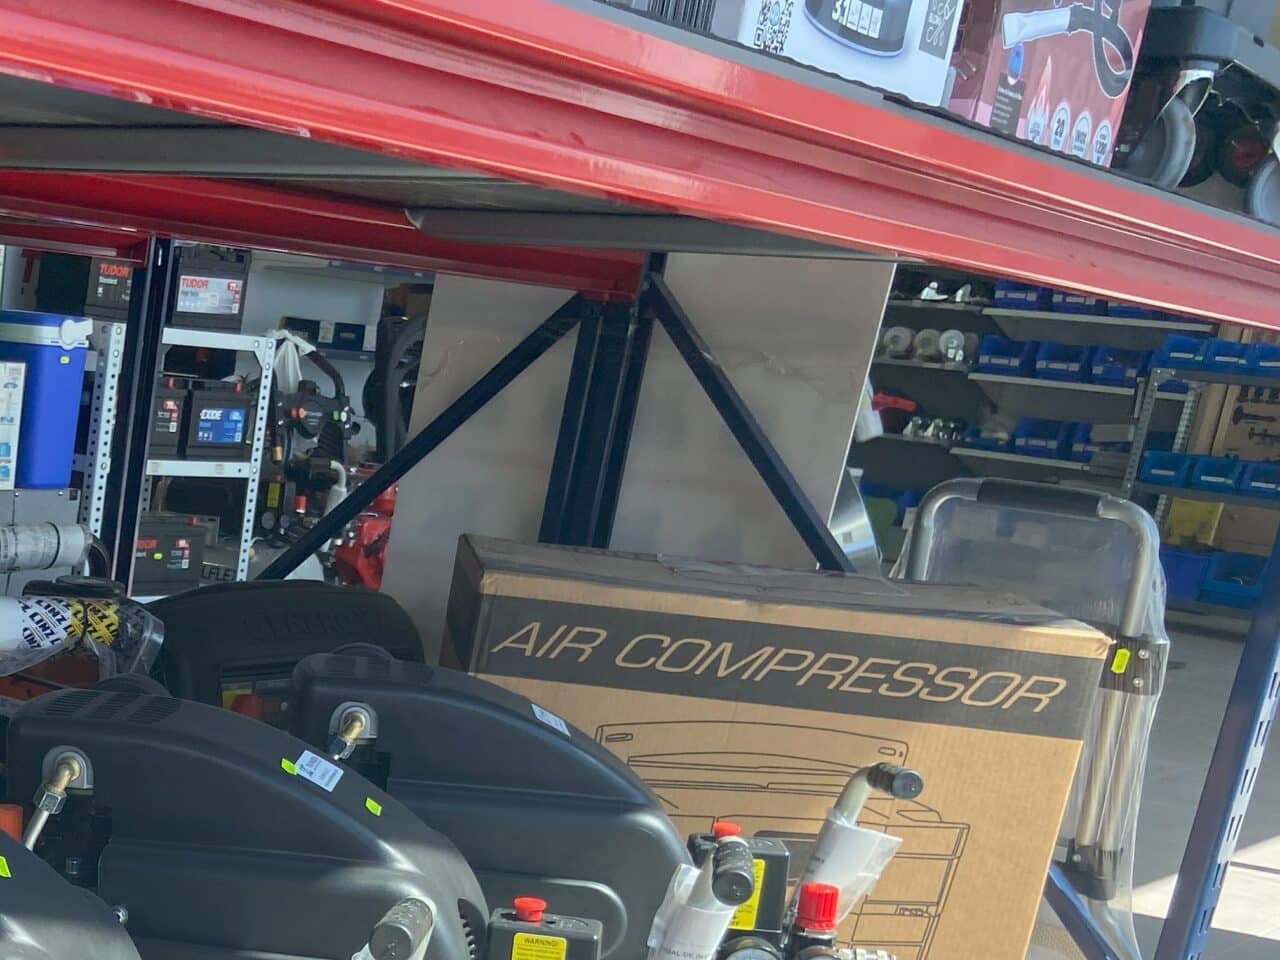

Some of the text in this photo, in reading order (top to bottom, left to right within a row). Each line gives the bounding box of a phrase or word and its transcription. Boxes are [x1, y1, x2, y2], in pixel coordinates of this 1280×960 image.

[99, 263, 130, 277] TUDOR
[181, 278, 209, 289] TUDOR
[28, 612, 55, 639] LINZ
[490, 621, 1066, 713] AIR COMPRESSOR
